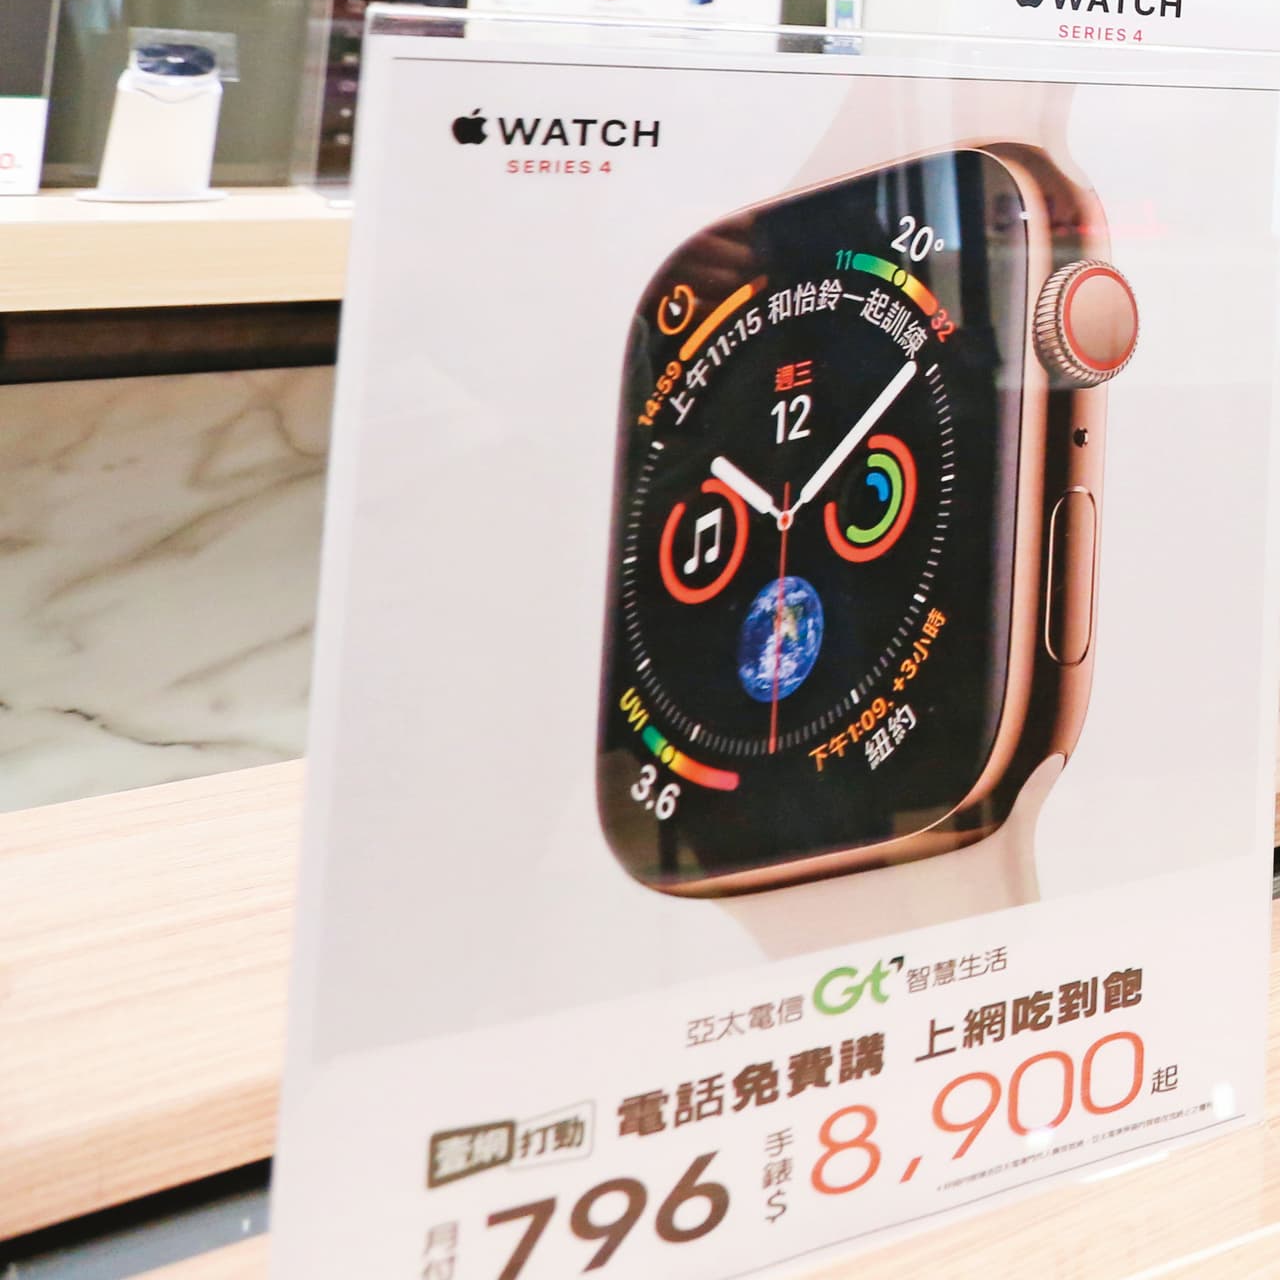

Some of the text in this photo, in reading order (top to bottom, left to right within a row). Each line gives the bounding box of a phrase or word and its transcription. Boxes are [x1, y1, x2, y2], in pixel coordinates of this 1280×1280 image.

[1059, 24, 1143, 43] SERIES 4
[497, 117, 660, 148] WATCH
[506, 159, 613, 174] SERIES 4
[835, 249, 853, 271] 11
[891, 215, 945, 262] 20°
[931, 308, 957, 343] 32
[669, 278, 929, 425] 上午11:15 和怡鈴一起訓練
[775, 359, 814, 393] 週三
[637, 360, 683, 426] 14:59
[770, 393, 813, 445] 12
[619, 687, 649, 733] UVI
[864, 703, 918, 771] 紐約
[630, 763, 682, 821] 3.6
[686, 946, 1008, 1048] 亞太電信 Gt 智慧生活
[617, 1031, 886, 1138] 電話免費講
[915, 967, 1144, 1063] 上網吃到飽
[486, 1150, 731, 1280] 796
[810, 1030, 1145, 1196] 8,900
[1151, 1064, 1178, 1095] 起
